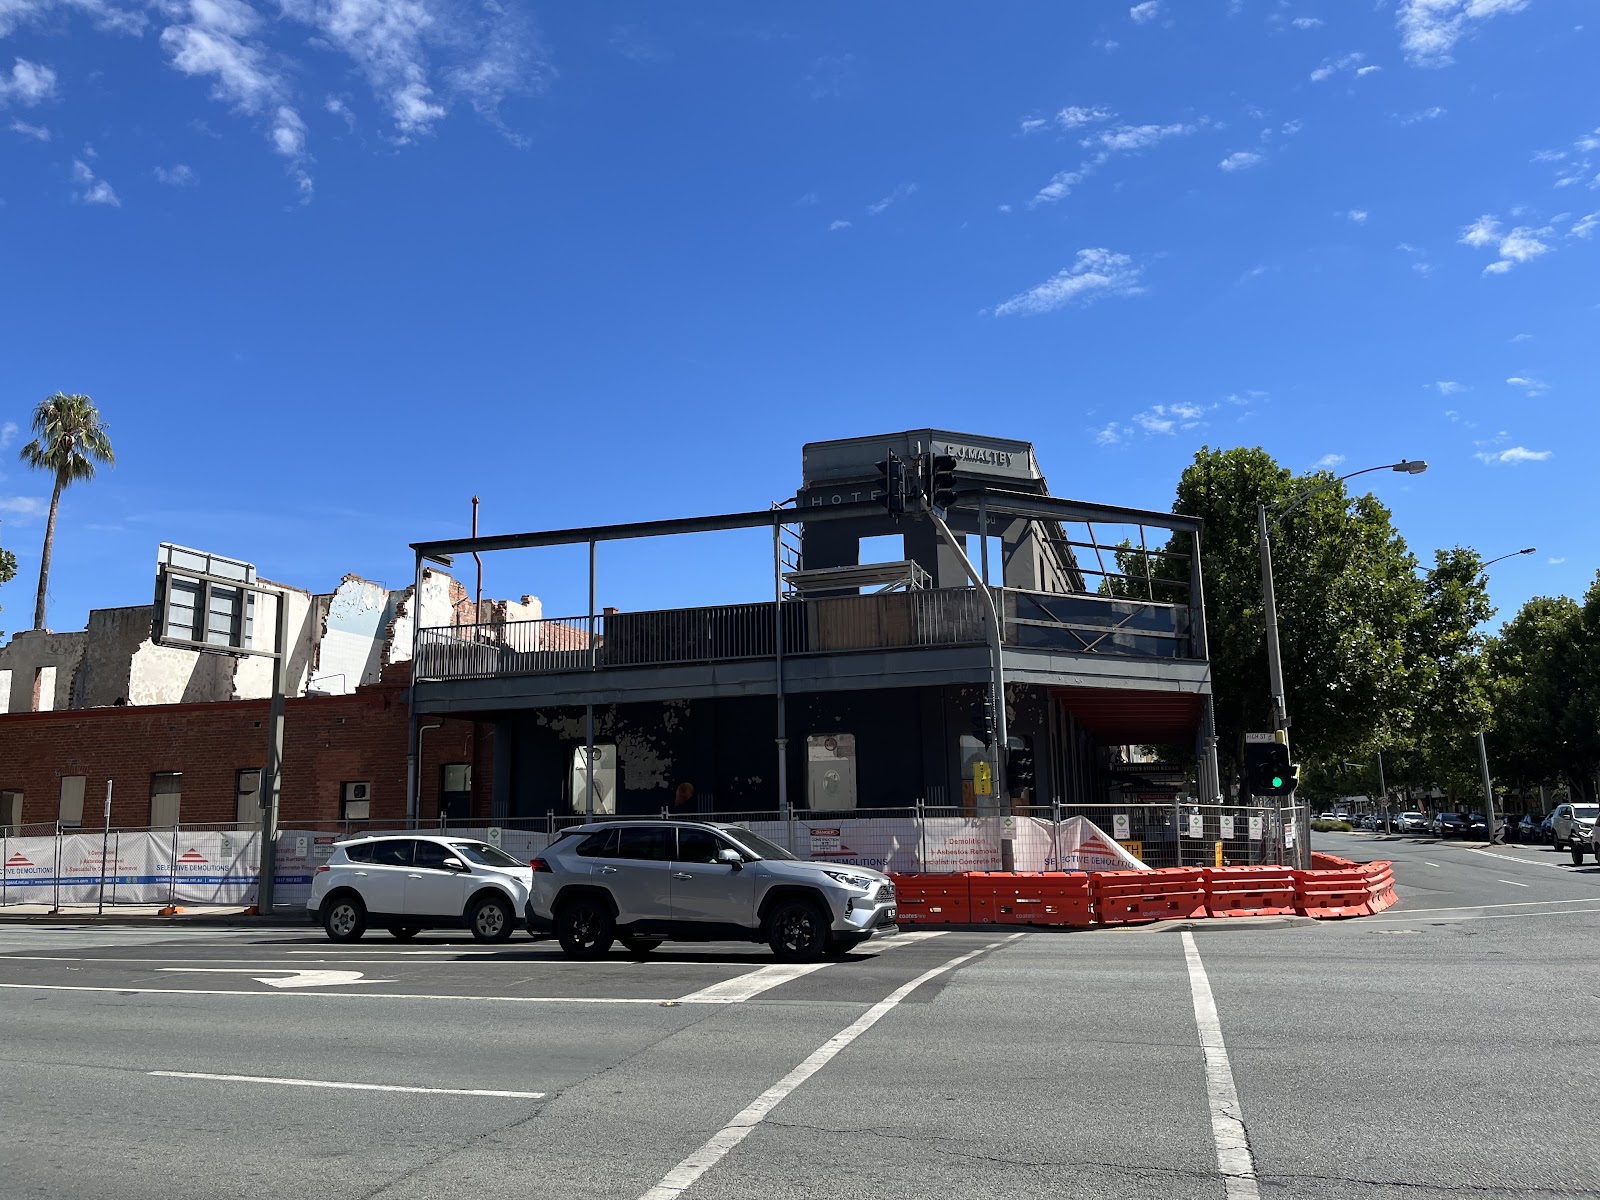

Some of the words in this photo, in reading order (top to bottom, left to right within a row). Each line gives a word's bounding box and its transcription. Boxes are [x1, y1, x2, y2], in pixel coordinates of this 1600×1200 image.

[971, 847, 999, 855] Removal
[1121, 844, 1139, 855] TH
[958, 858, 990, 866] Concrete
[16, 867, 54, 875] DEMOLITIONS
[189, 864, 230, 872] DEMOLITIONS
